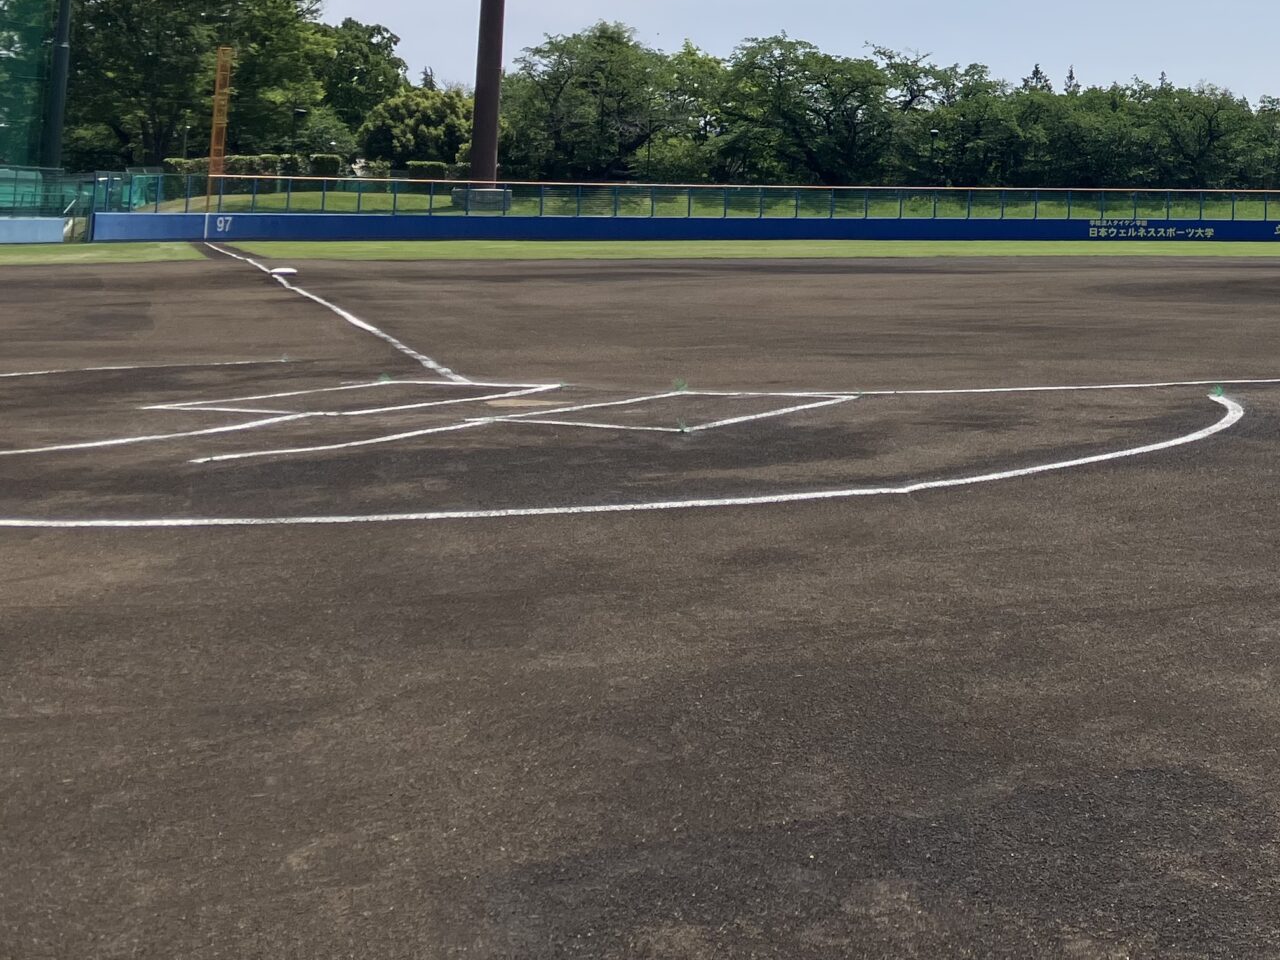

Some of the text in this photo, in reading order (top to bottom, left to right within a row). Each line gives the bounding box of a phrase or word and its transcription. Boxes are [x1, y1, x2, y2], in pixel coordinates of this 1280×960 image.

[216, 216, 232, 232] 97
[1089, 227, 1215, 238] 日本ウェルネススポーツ大学
